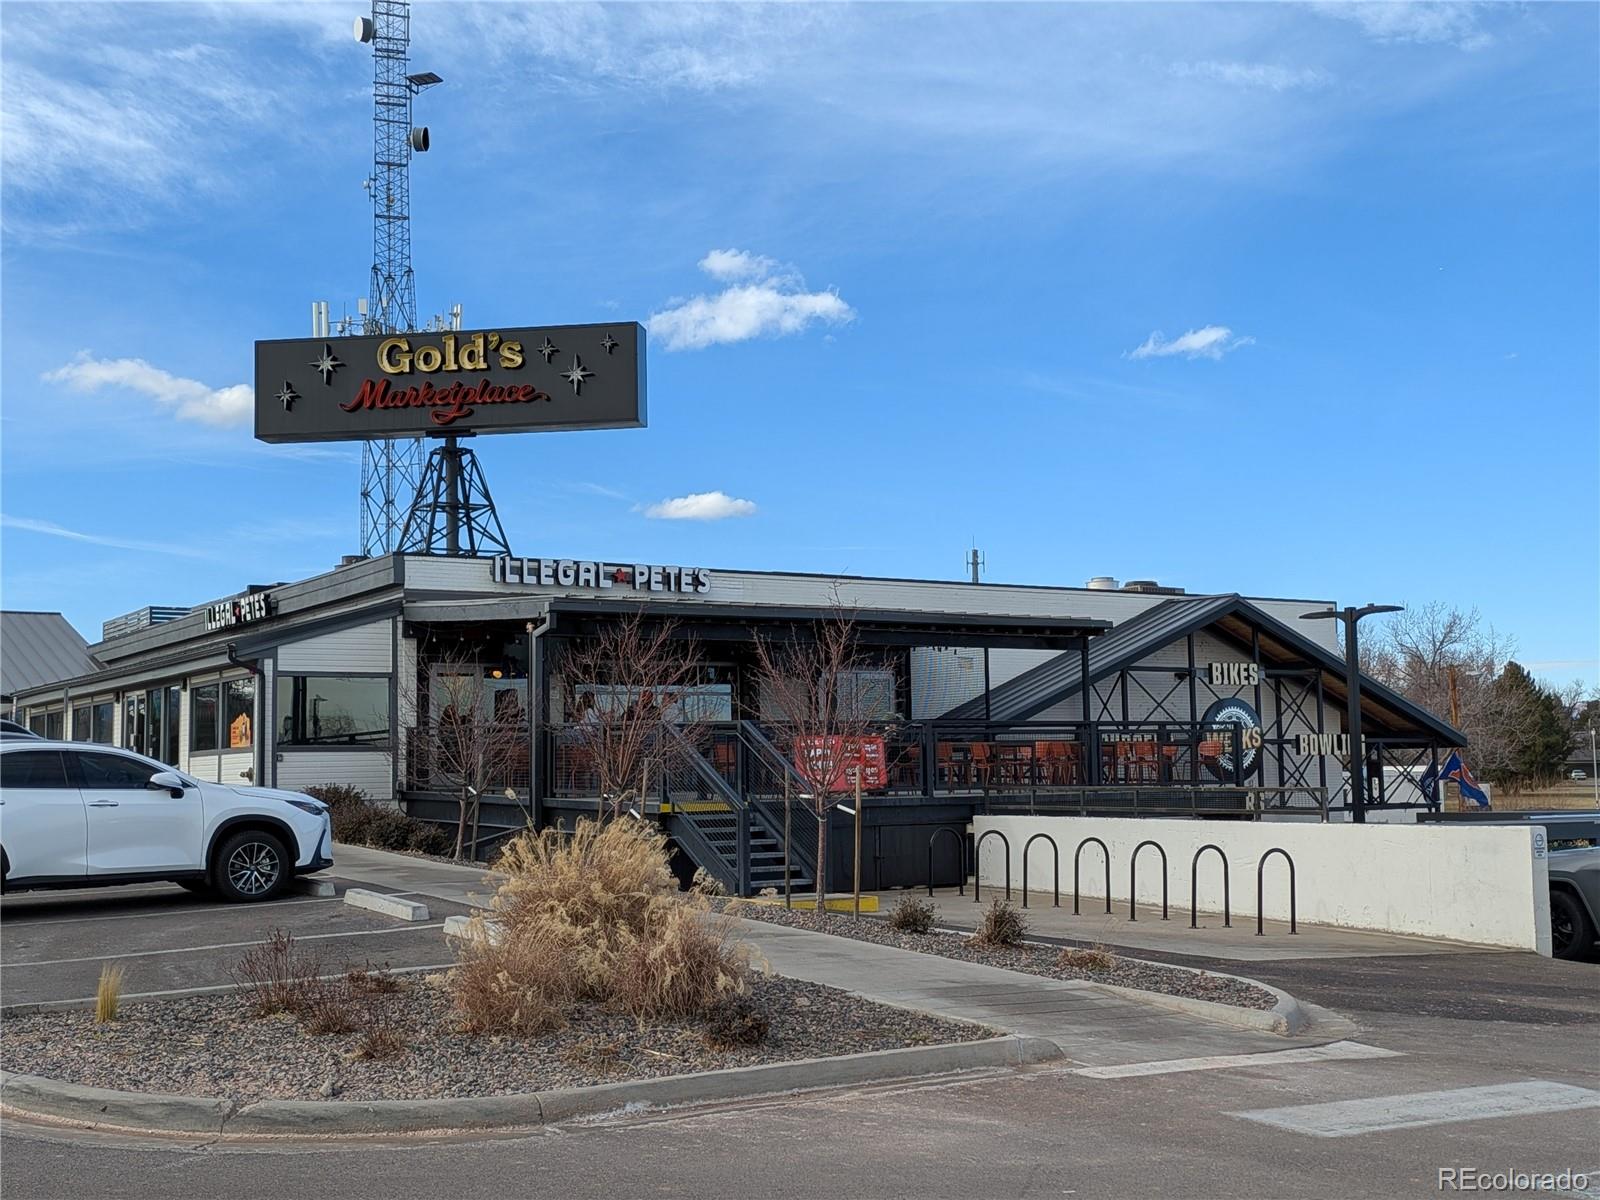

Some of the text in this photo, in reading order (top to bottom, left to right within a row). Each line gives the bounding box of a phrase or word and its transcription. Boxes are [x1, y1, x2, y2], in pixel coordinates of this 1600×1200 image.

[376, 332, 524, 374] Gold's
[338, 377, 551, 425] Marketplace
[493, 555, 712, 594] ILLEGAL PETE'S
[204, 600, 237, 632] ILLEGAL
[1211, 662, 1260, 686] BIKES
